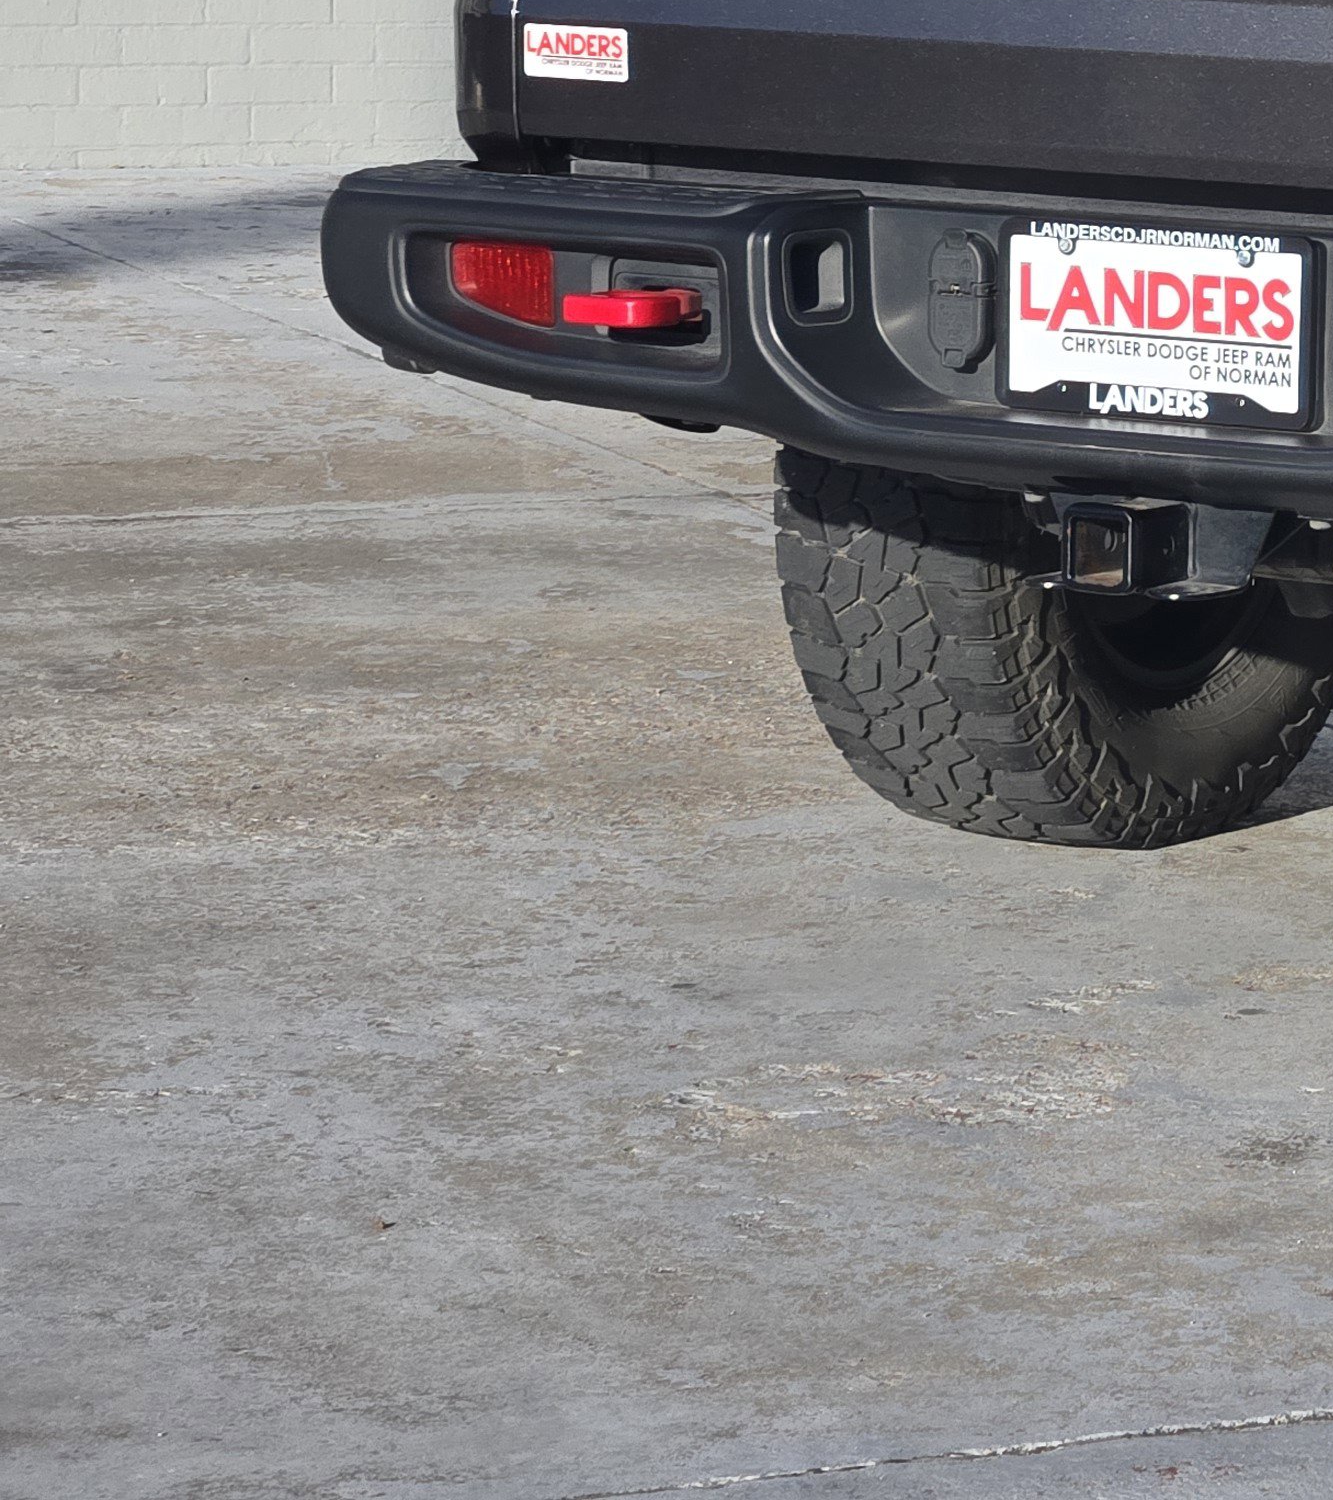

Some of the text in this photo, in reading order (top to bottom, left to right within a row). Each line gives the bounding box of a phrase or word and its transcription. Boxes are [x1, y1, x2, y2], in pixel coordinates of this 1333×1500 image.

[527, 30, 622, 58] LANDERS
[1030, 221, 1280, 252] LANDERSCDJRNORMAN.COM
[1020, 262, 1294, 341] LANDERS
[1062, 336, 1292, 368] CHRYSLER DODGE JEEP RAM
[1189, 365, 1292, 388] OF NORMAN
[1088, 382, 1210, 419] LANDERS
